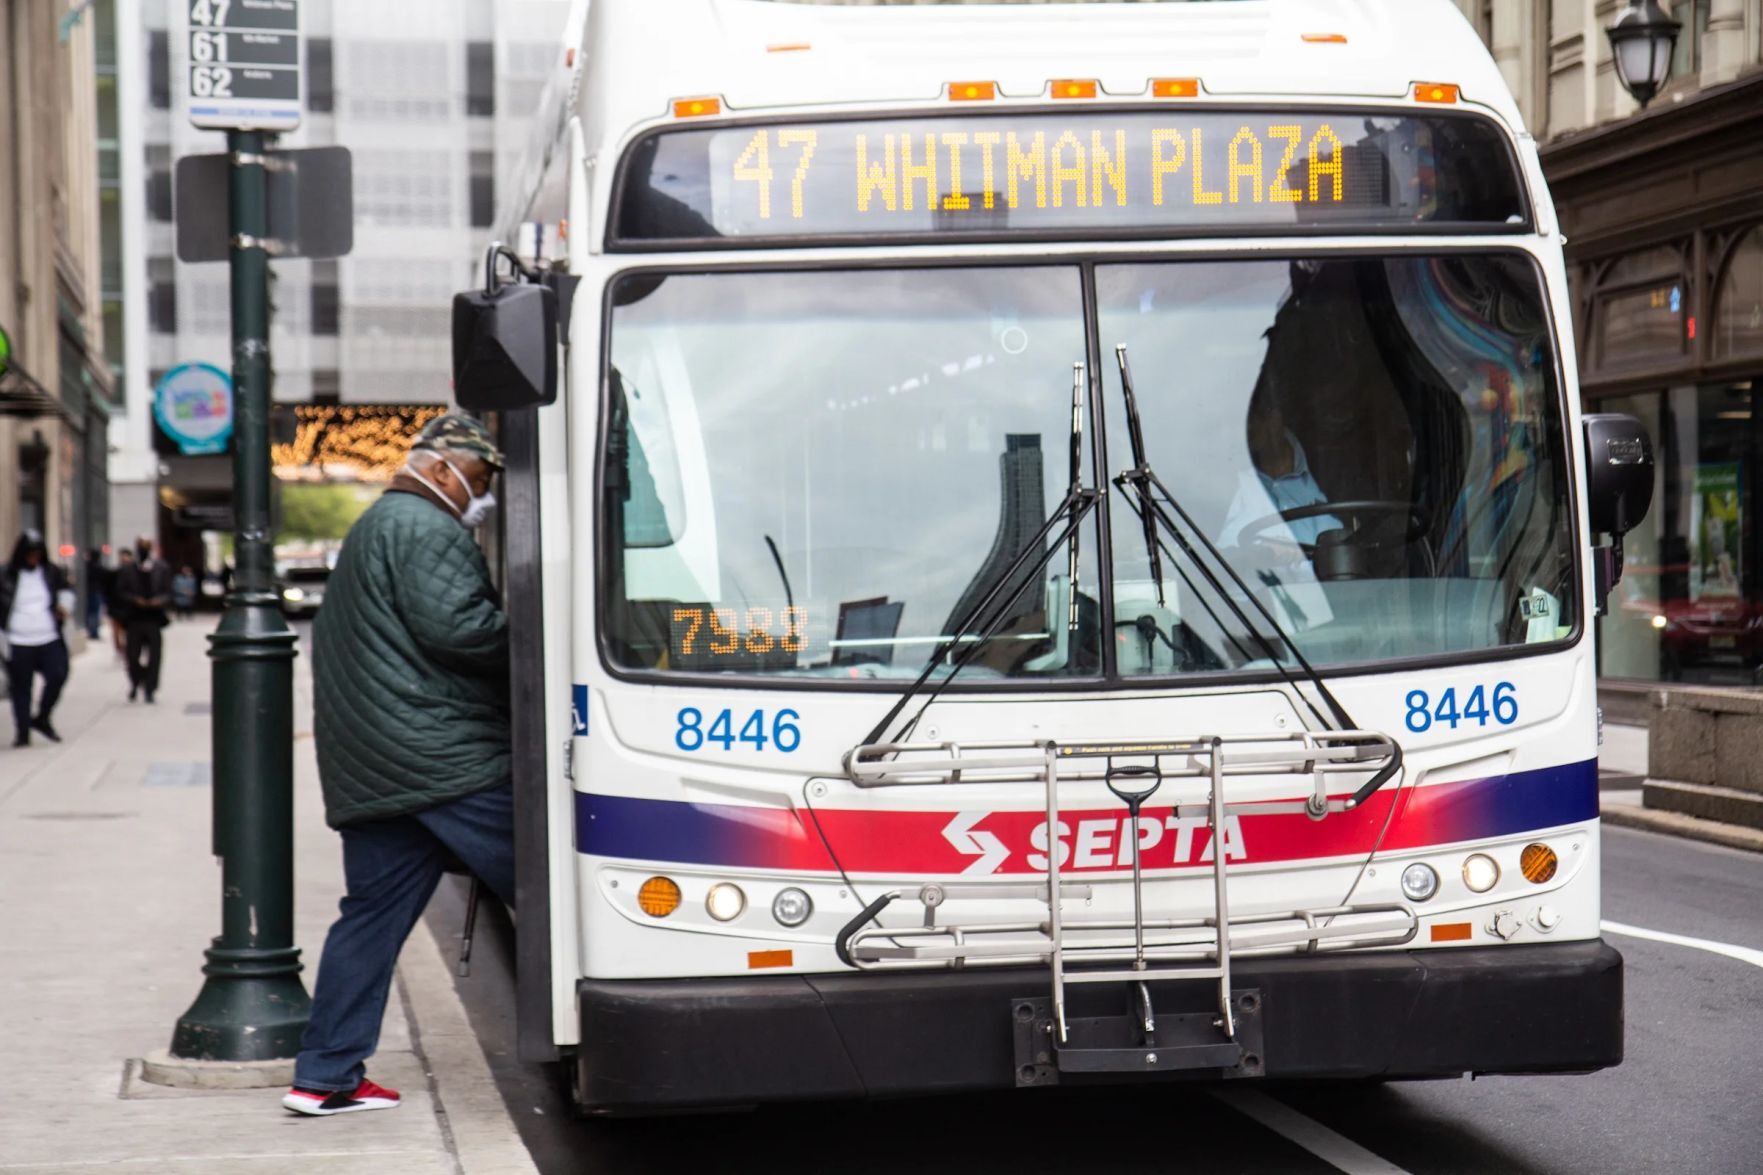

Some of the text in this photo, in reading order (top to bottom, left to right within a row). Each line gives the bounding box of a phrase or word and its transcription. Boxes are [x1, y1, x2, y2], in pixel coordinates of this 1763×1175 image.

[191, 0, 230, 26] 47
[192, 31, 228, 61] 61
[192, 66, 232, 97] 62
[734, 124, 1342, 218] 47 WHITMAN PLAZA
[673, 606, 809, 655] 7988
[675, 707, 801, 752] 8446
[1405, 682, 1518, 732] 8446
[1026, 815, 1248, 872] SEPTA
